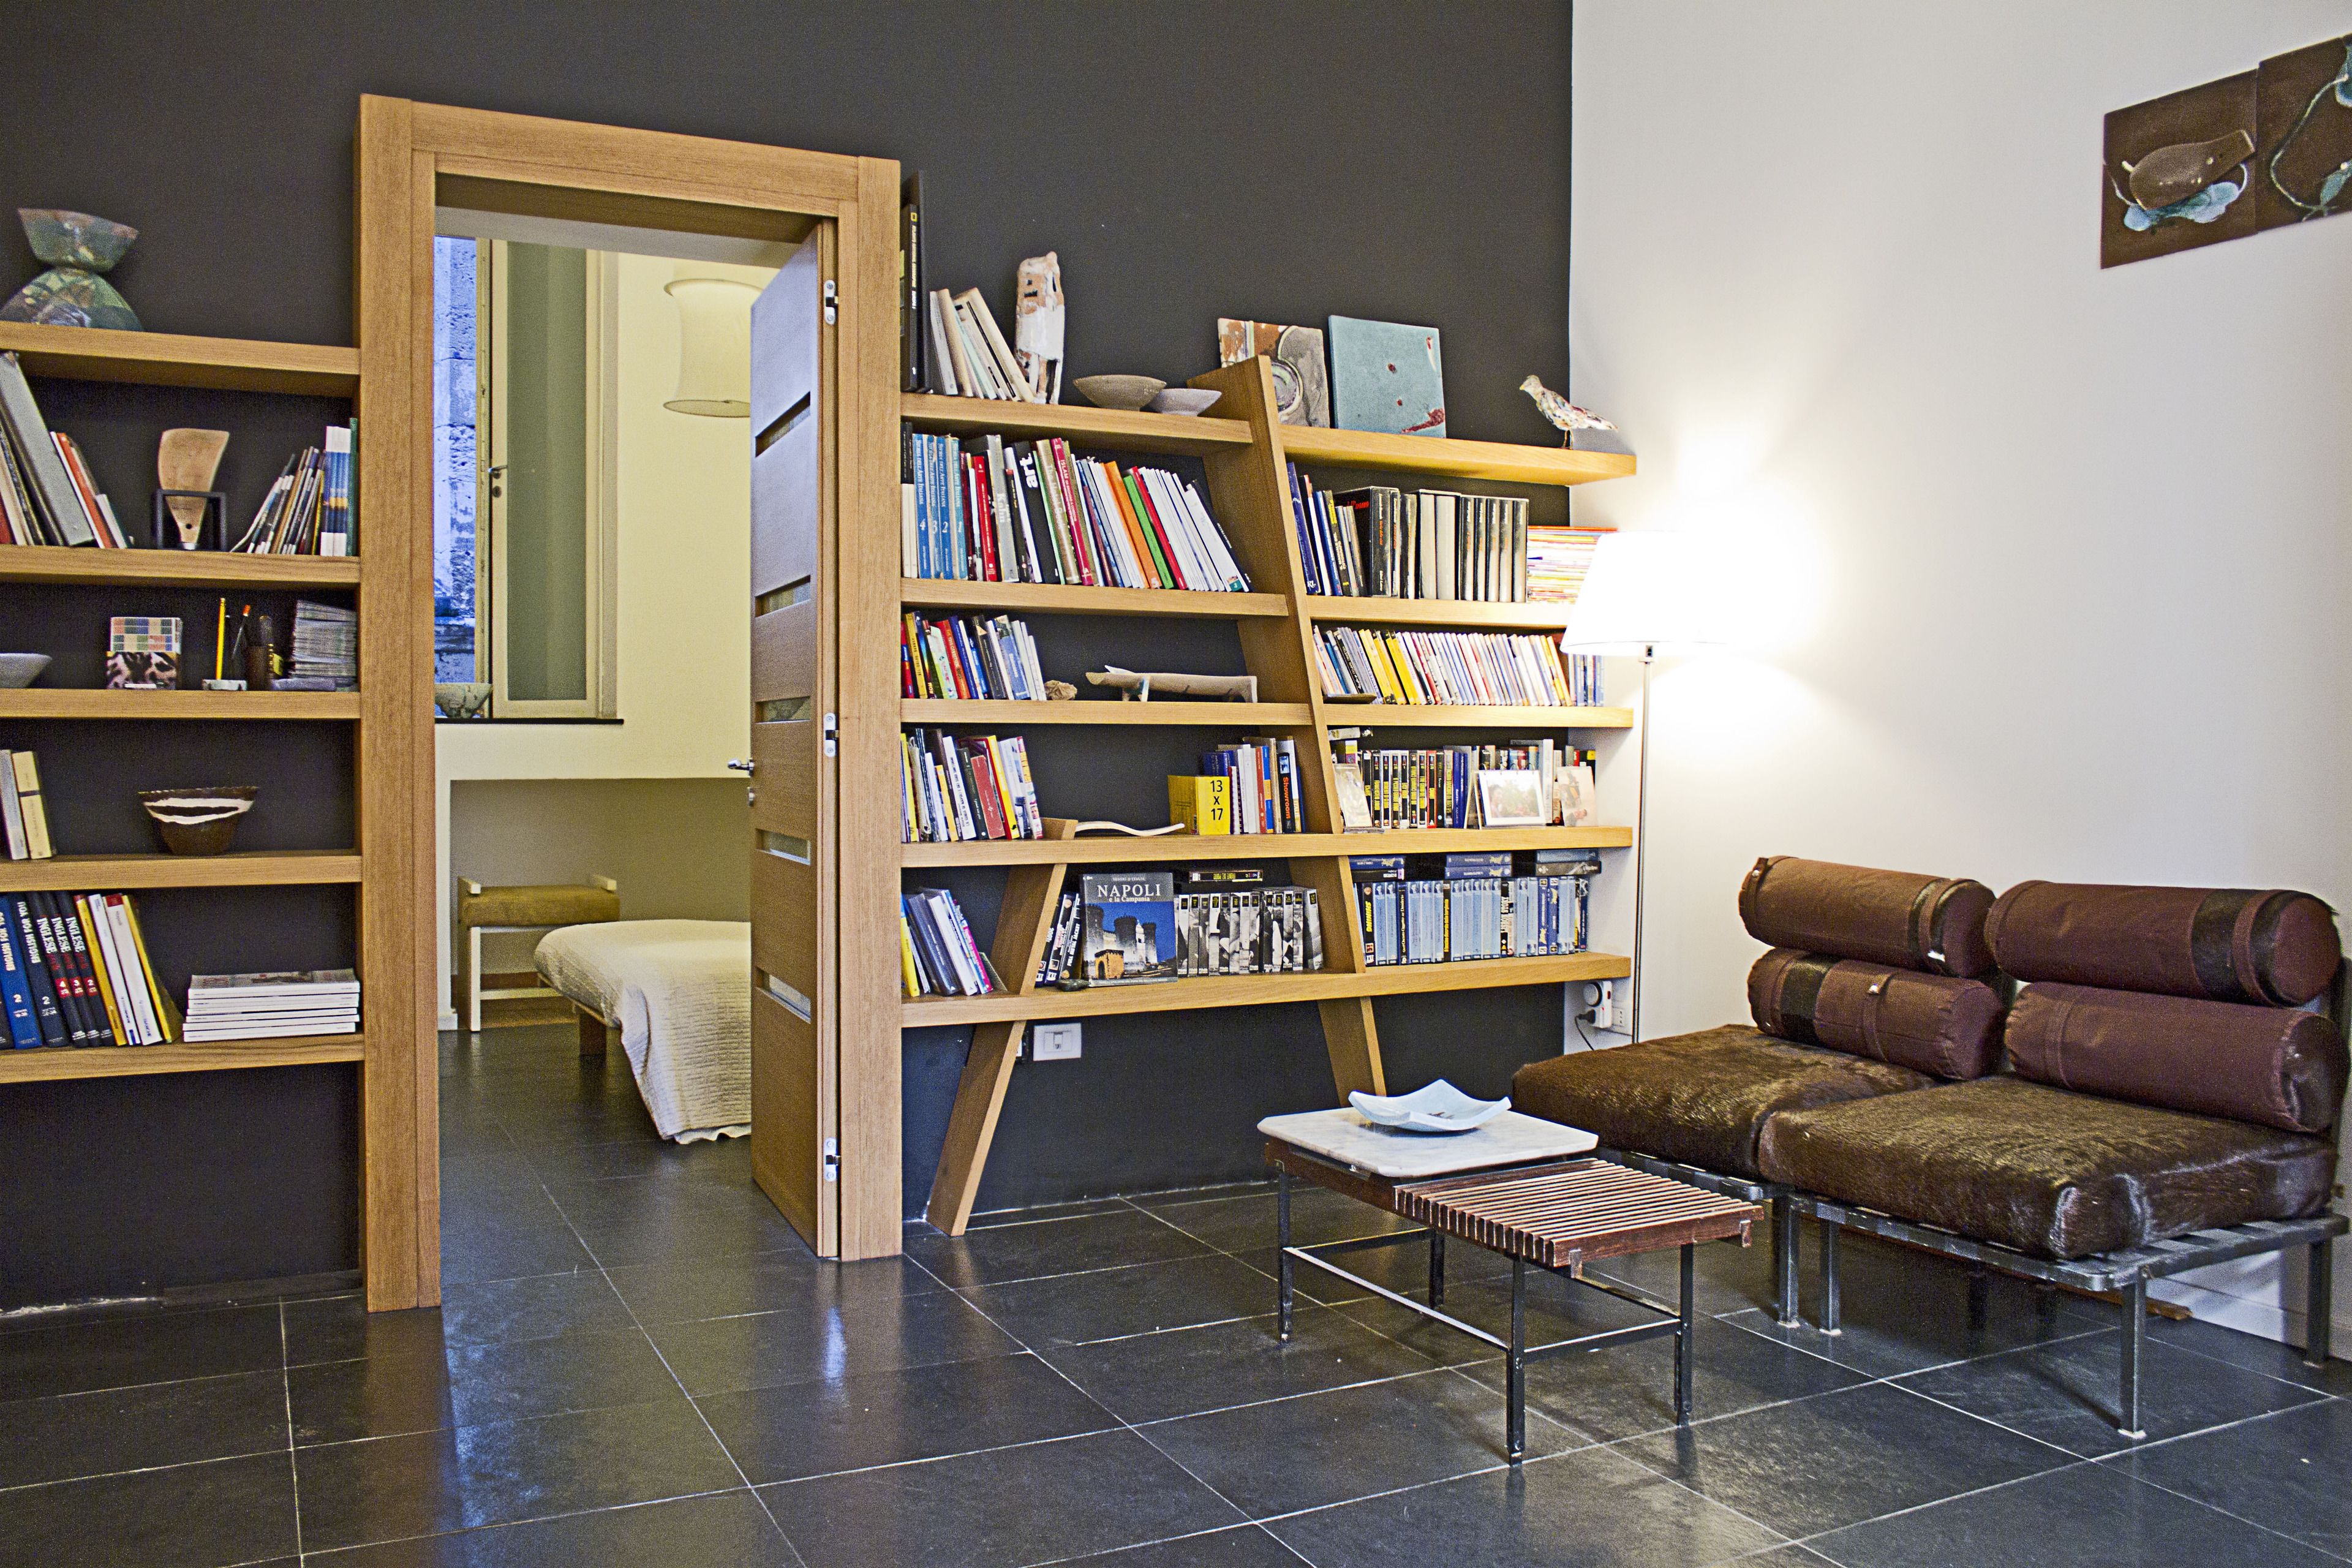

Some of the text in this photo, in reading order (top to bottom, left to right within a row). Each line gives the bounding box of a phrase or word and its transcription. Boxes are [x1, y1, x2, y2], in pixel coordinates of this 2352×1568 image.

[1019, 453, 1039, 488] art.
[1060, 460, 1069, 479] ISLAM
[996, 492, 1006, 523] Kahn
[919, 519, 926, 531] 4
[941, 521, 948, 533] 2
[957, 521, 962, 532] 1
[1210, 780, 1223, 792] 13
[1213, 796, 1219, 805] x
[1282, 777, 1291, 819] Showroom
[1211, 809, 1223, 820] 17
[1097, 884, 1161, 897] NAPOLI
[0, 927, 9, 942] FOR
[17, 902, 42, 964] ENGLISH FOR YOU
[36, 918, 58, 954] INGLESE
[51, 916, 72, 953] INGLESE
[65, 916, 86, 953] INGLESE
[1, 943, 16, 971] ENGLISH
[13, 994, 22, 1003] 2
[42, 996, 50, 1005] 2
